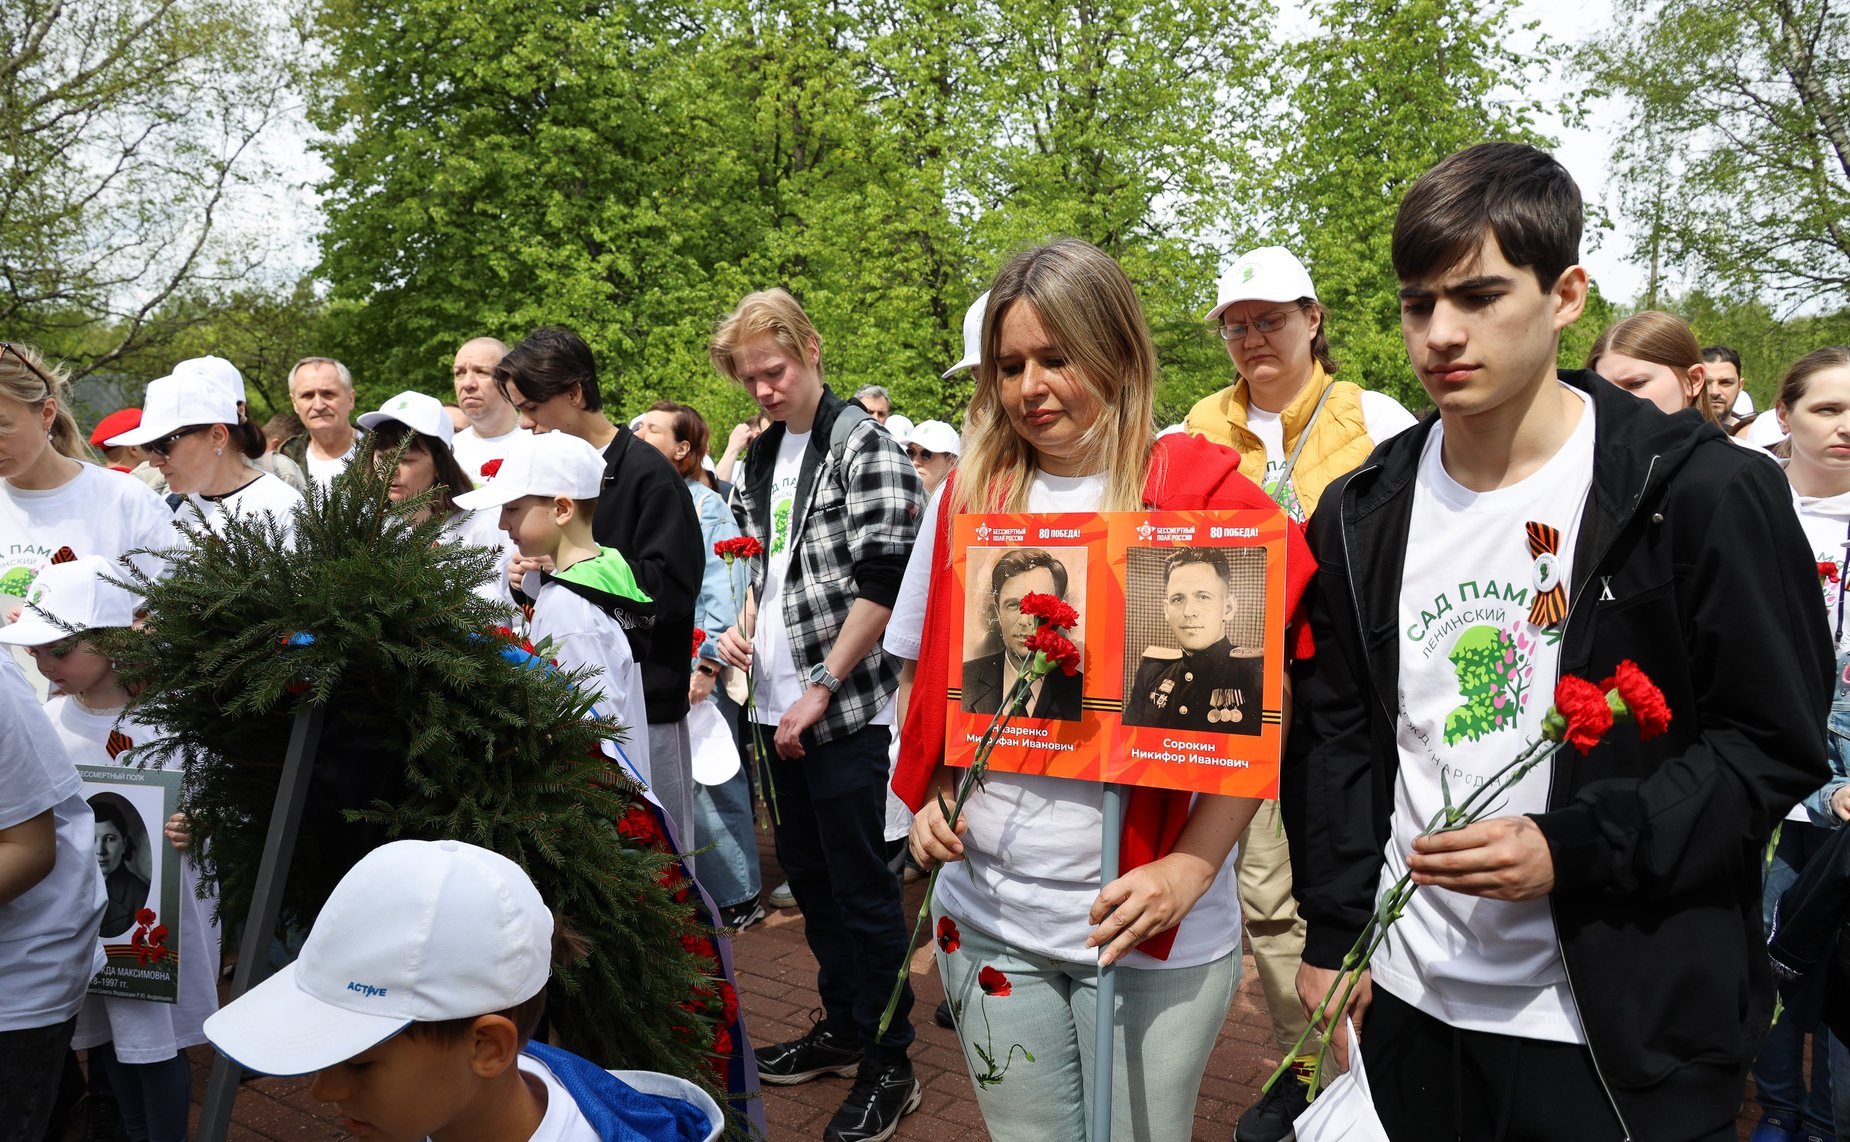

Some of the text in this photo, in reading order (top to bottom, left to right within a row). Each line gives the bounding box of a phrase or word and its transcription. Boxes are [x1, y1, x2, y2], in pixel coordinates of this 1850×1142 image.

[992, 527, 1026, 535] БЕССМЕРТНЫЙ
[1038, 528, 1080, 539] 80 ПОБЕДА!
[1156, 526, 1195, 534] БЕССМЕРТНЫЙ
[1210, 526, 1259, 538] 80 ПОБЕДА!
[10, 544, 52, 558] ПАМ
[1406, 579, 1563, 647] САД ПАМИ
[1421, 607, 1506, 659] ЛЕНИНСКИЙ
[1021, 737, 1074, 752] Иванович
[1162, 737, 1216, 753] Сорокин
[1131, 748, 1250, 769] Никифор Иванович
[125, 773, 145, 781] ПОЛК
[117, 968, 171, 981] МАКСИМОВНА
